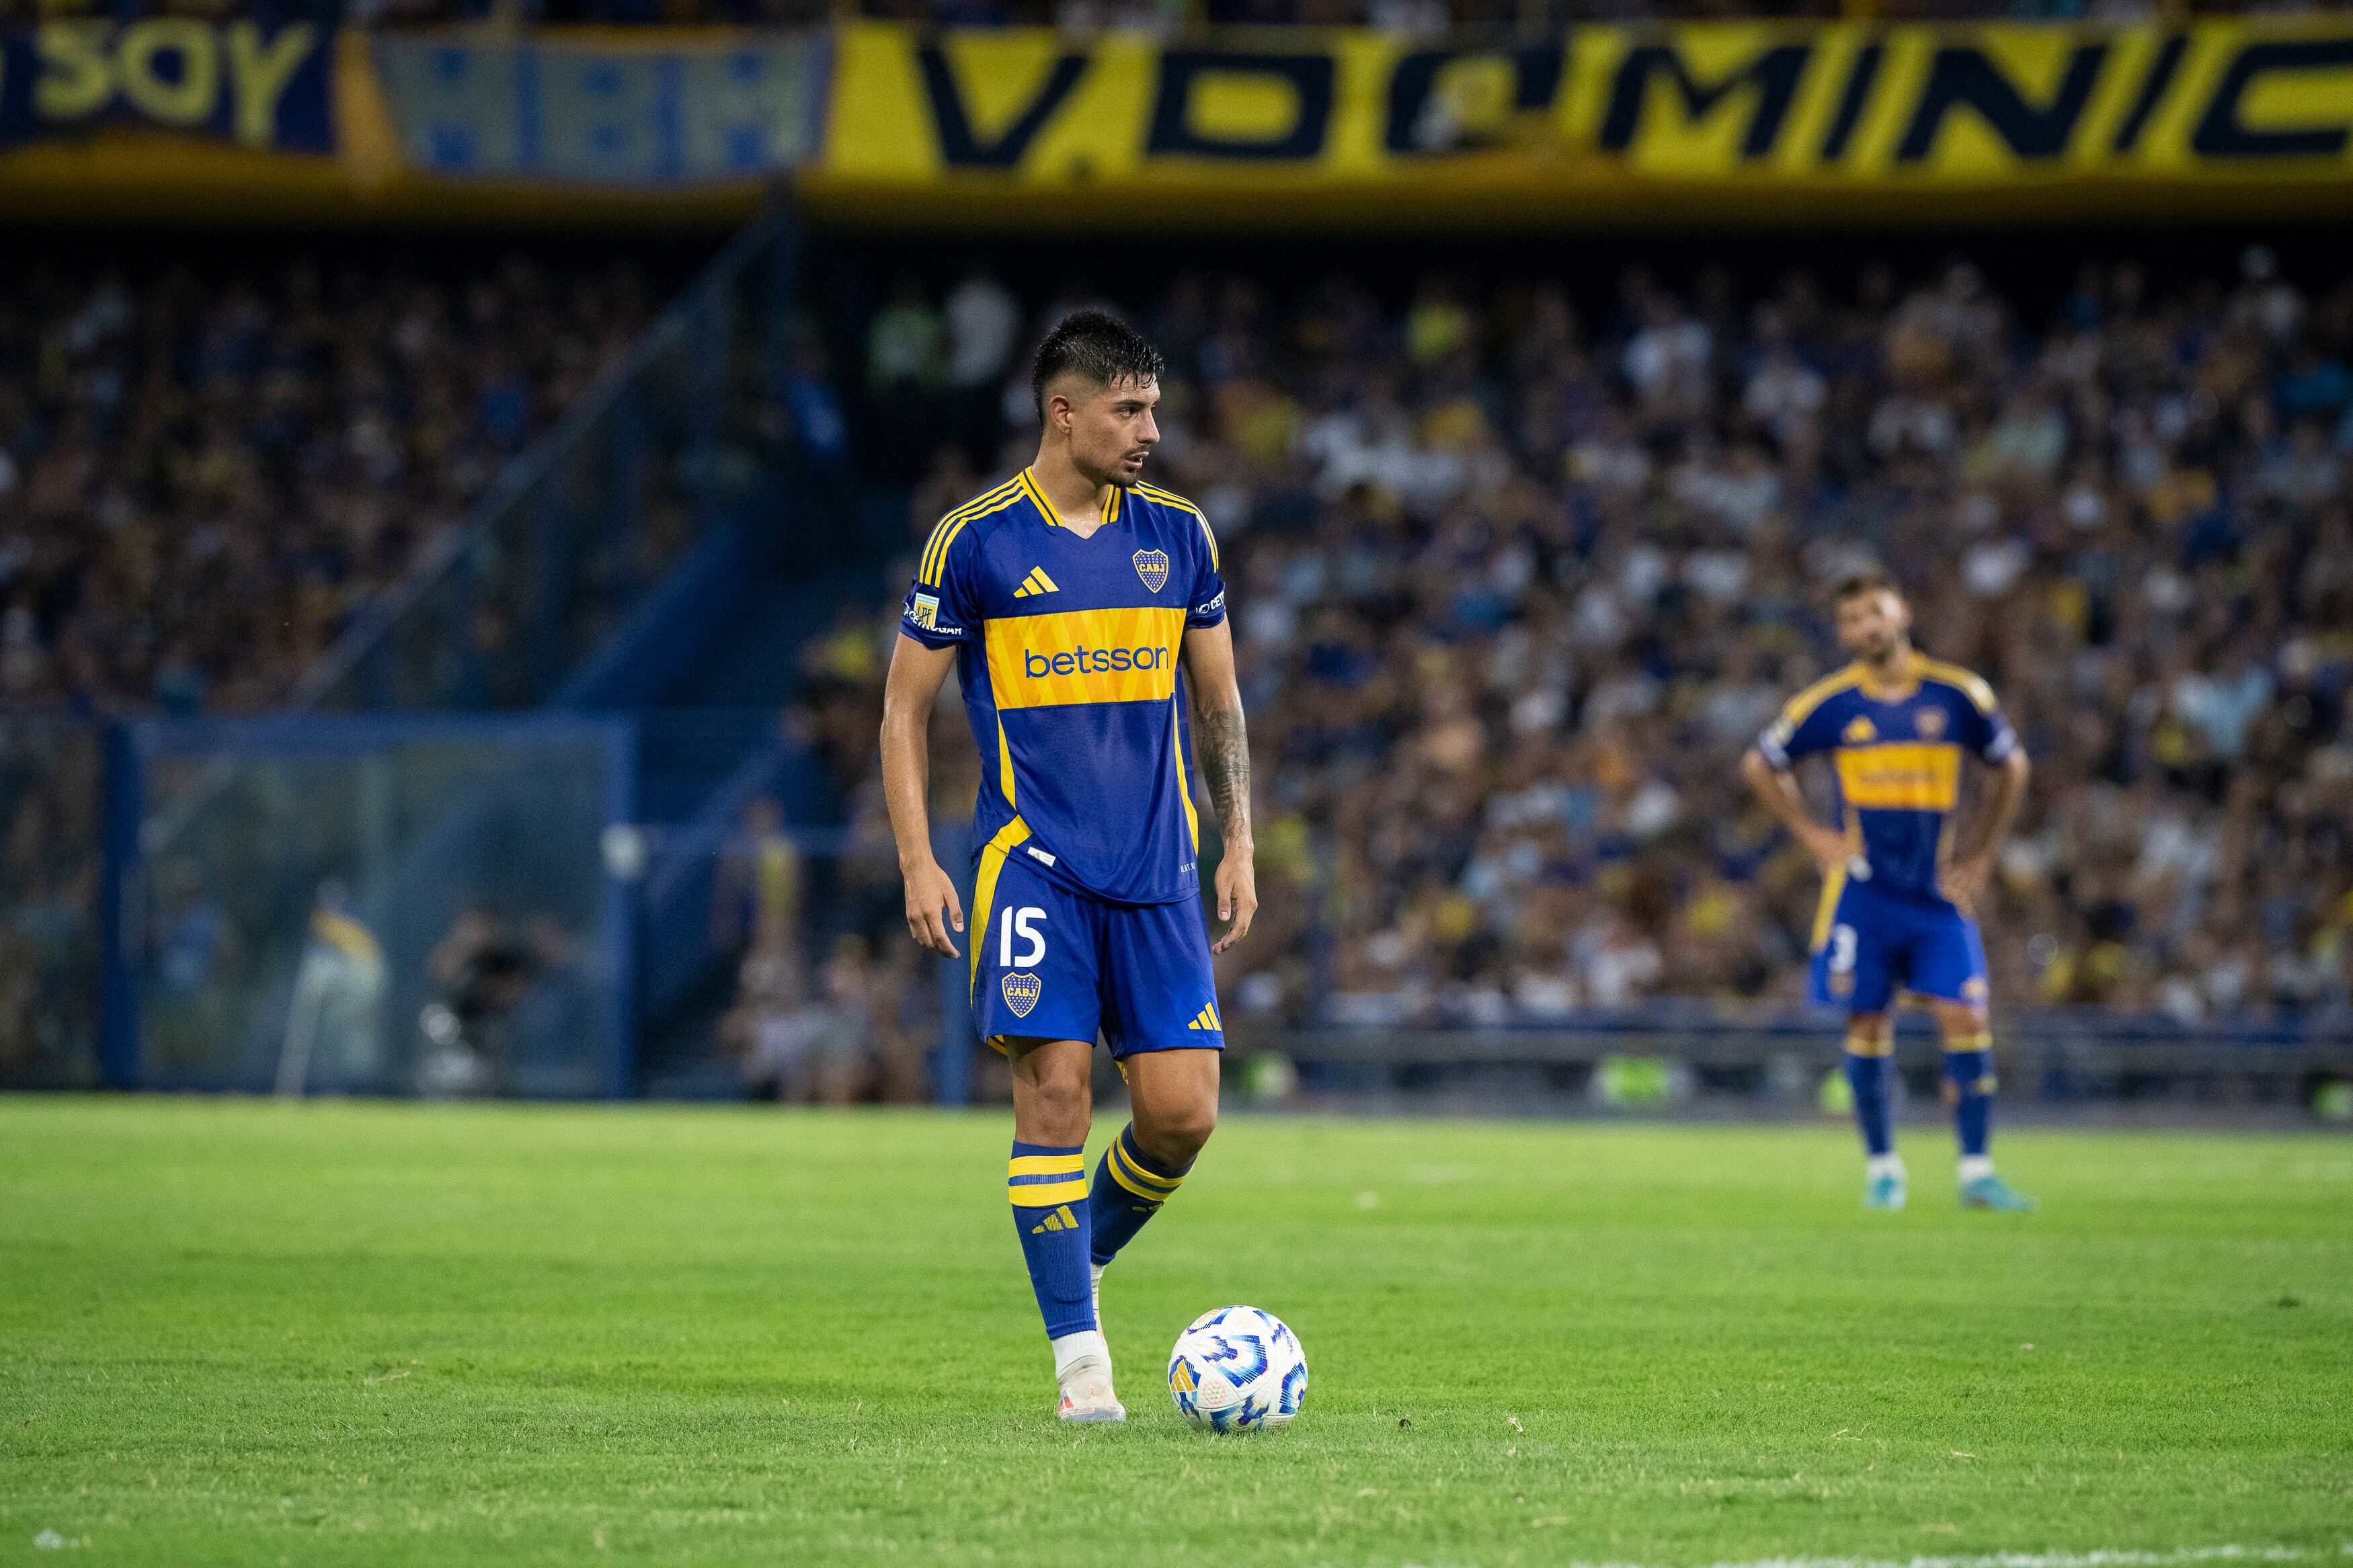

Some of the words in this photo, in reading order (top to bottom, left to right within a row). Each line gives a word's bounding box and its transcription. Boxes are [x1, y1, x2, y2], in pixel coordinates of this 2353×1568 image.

[34, 17, 316, 144] SOY
[1140, 563, 1165, 572] CABJ
[1025, 645, 1168, 677] betsson
[1000, 906, 1047, 967] 15
[1007, 987, 1036, 997] CABJ
